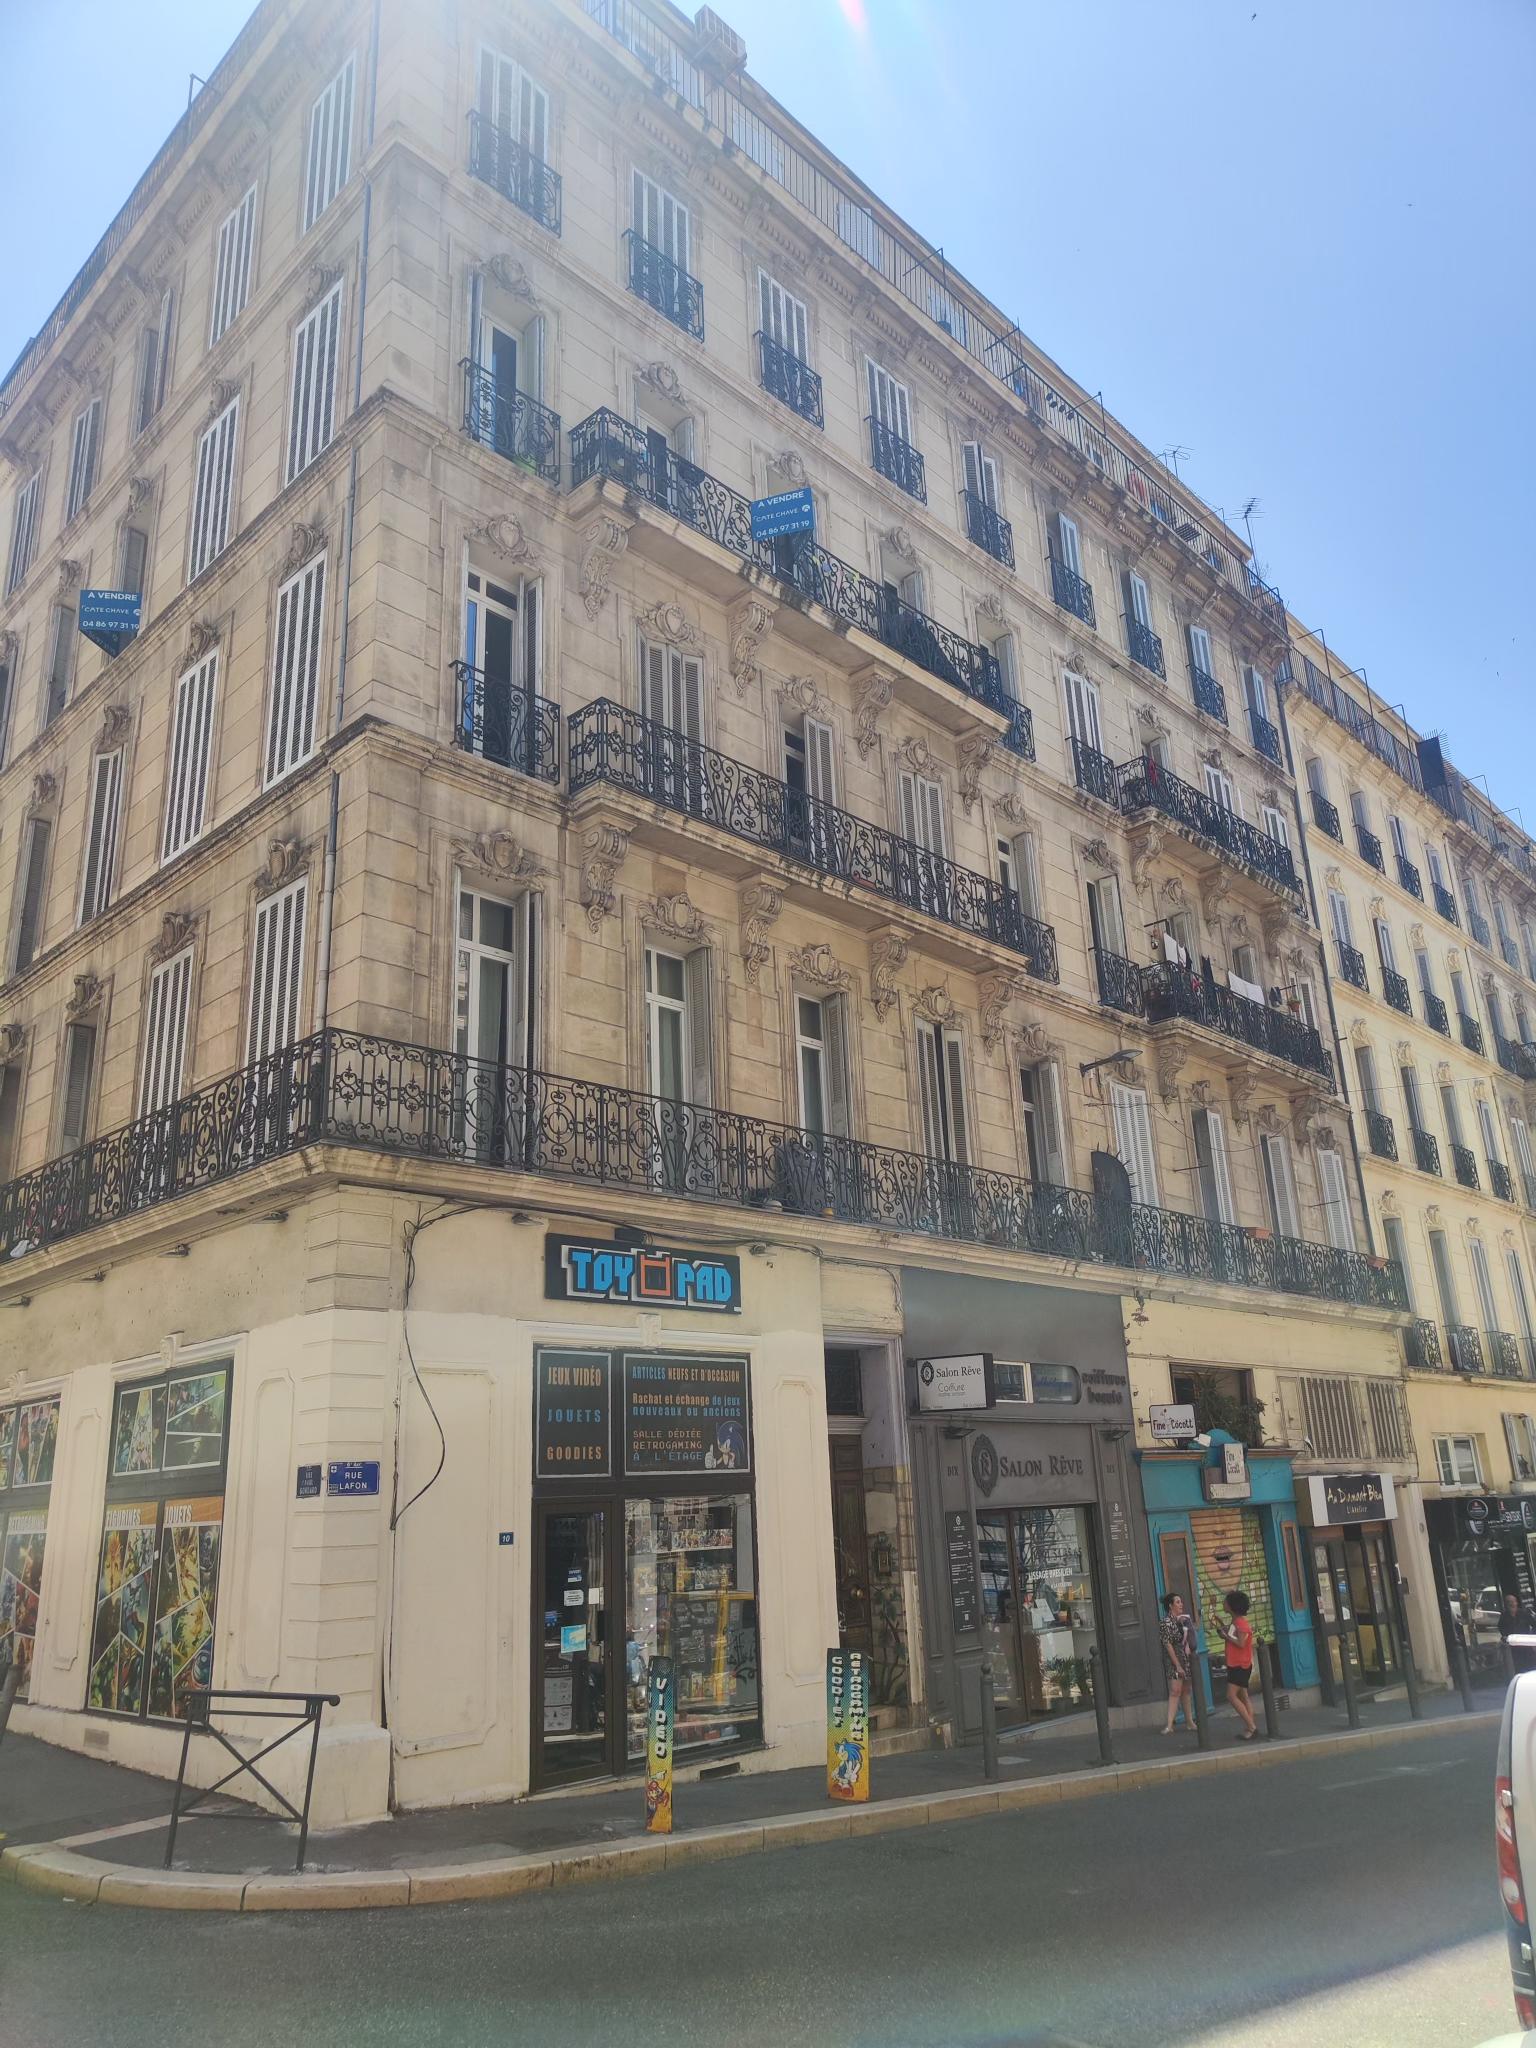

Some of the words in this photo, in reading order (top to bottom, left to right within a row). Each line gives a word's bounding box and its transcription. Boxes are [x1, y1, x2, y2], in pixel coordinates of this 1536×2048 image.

[767, 491, 804, 505] VENDRE
[98, 592, 138, 601] VENDRE
[571, 1250, 636, 1294] TOY
[676, 1263, 732, 1302] PAD
[547, 1367, 571, 1386] JEUX
[573, 1365, 601, 1387] VIDÉO
[632, 1366, 666, 1380] ARTICLES
[667, 1367, 689, 1381] NEUFS
[691, 1368, 699, 1381] ET
[700, 1369, 740, 1383] D'OCCASION
[936, 1368, 959, 1378] Salon
[961, 1366, 982, 1376] Rêve
[633, 1393, 662, 1405] Rachat
[665, 1394, 673, 1405] et
[675, 1394, 710, 1406] échange
[712, 1395, 721, 1406] de
[724, 1395, 740, 1407] jeux
[547, 1409, 601, 1423] JOUETS
[633, 1406, 682, 1416] nouveaux
[686, 1407, 698, 1416] ou
[703, 1407, 741, 1417] anciens
[1153, 1420, 1166, 1430] Fine
[633, 1430, 662, 1438] SALLE
[668, 1428, 702, 1438] DÉDIÉE
[633, 1440, 702, 1450] RETROGAMING
[547, 1446, 602, 1461] GOODIES
[1000, 1458, 1042, 1477] SALON
[1049, 1455, 1084, 1476] RÊVE
[340, 1482, 368, 1490] LAFON
[105, 1505, 141, 1528] FIGURINES
[164, 1504, 193, 1525] JOUETS
[502, 1534, 511, 1543] 10
[831, 1656, 844, 1728] GOODIES
[655, 1677, 668, 1759] VIDEO
